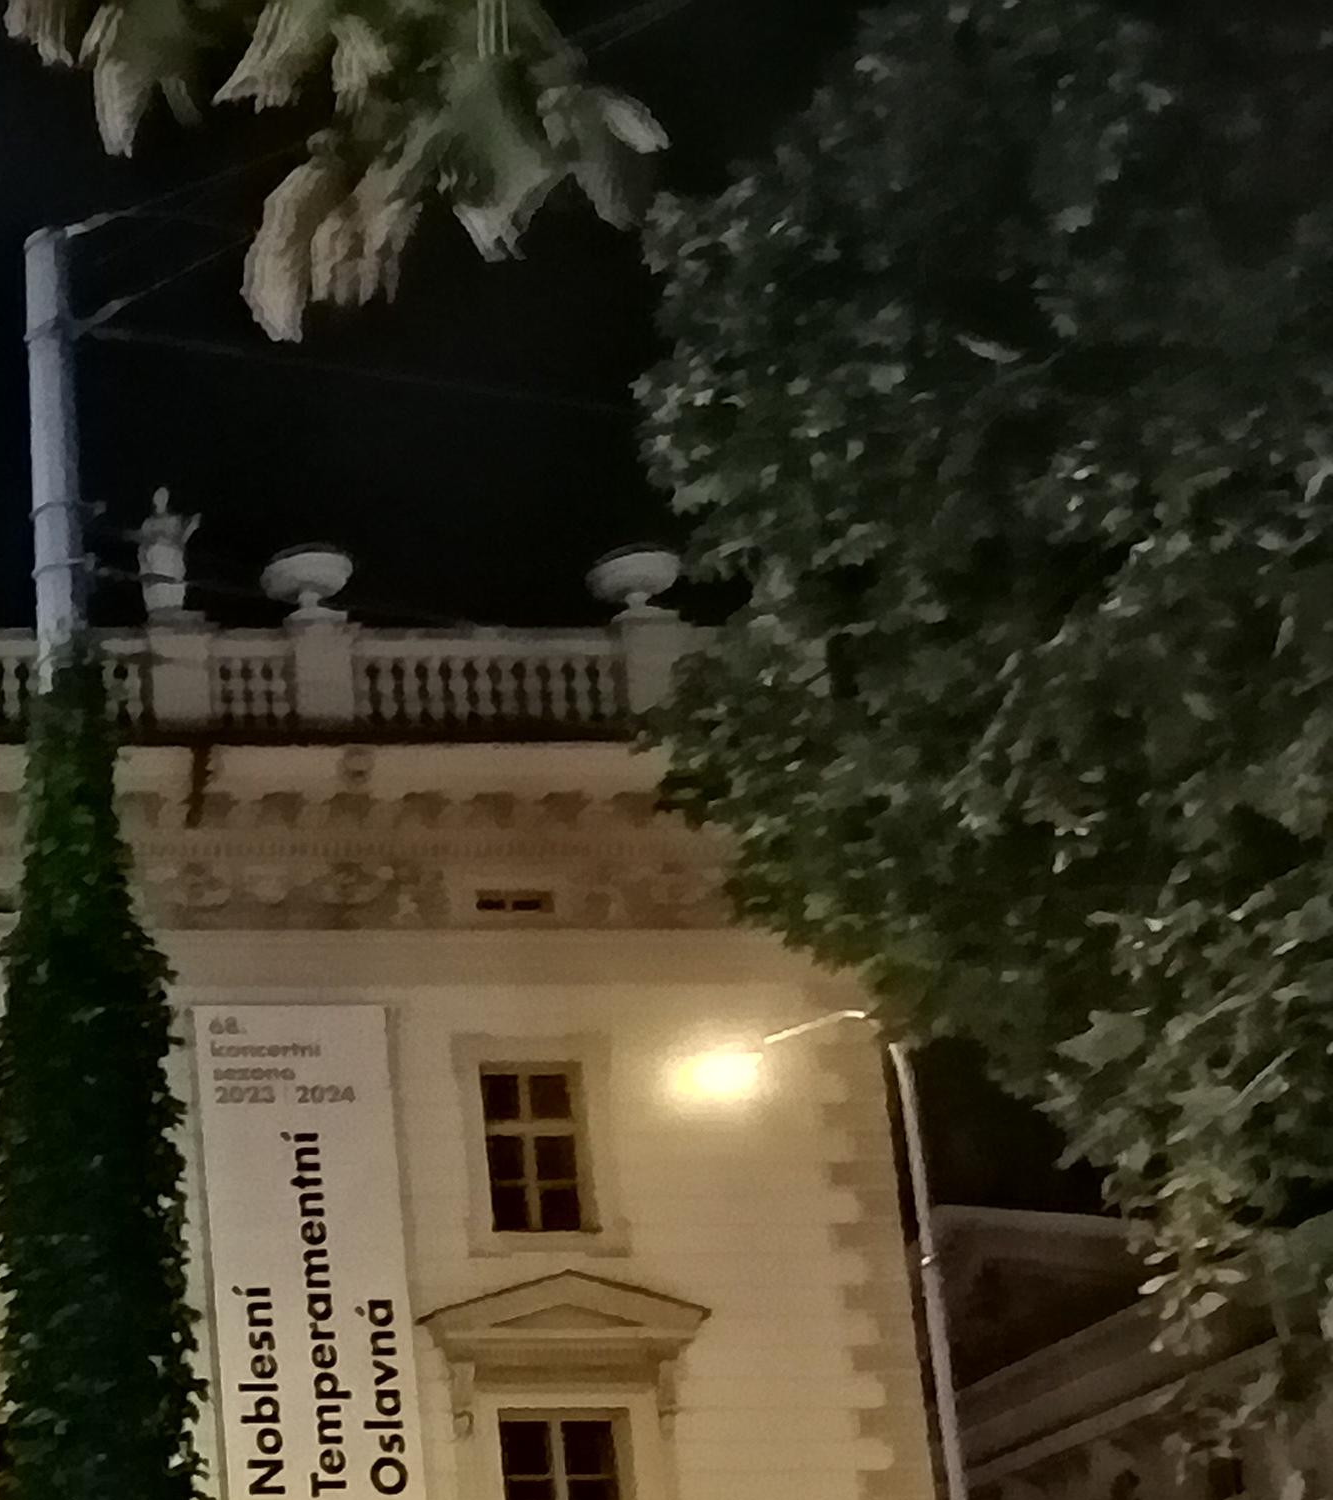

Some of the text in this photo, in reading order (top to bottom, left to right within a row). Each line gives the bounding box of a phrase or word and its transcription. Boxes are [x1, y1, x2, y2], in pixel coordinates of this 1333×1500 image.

[214, 1084, 356, 1104] 2023 2024
[233, 1284, 285, 1496] Noblesní
[280, 1131, 352, 1498] Temperamentní
[354, 1299, 408, 1496] Oslavná
